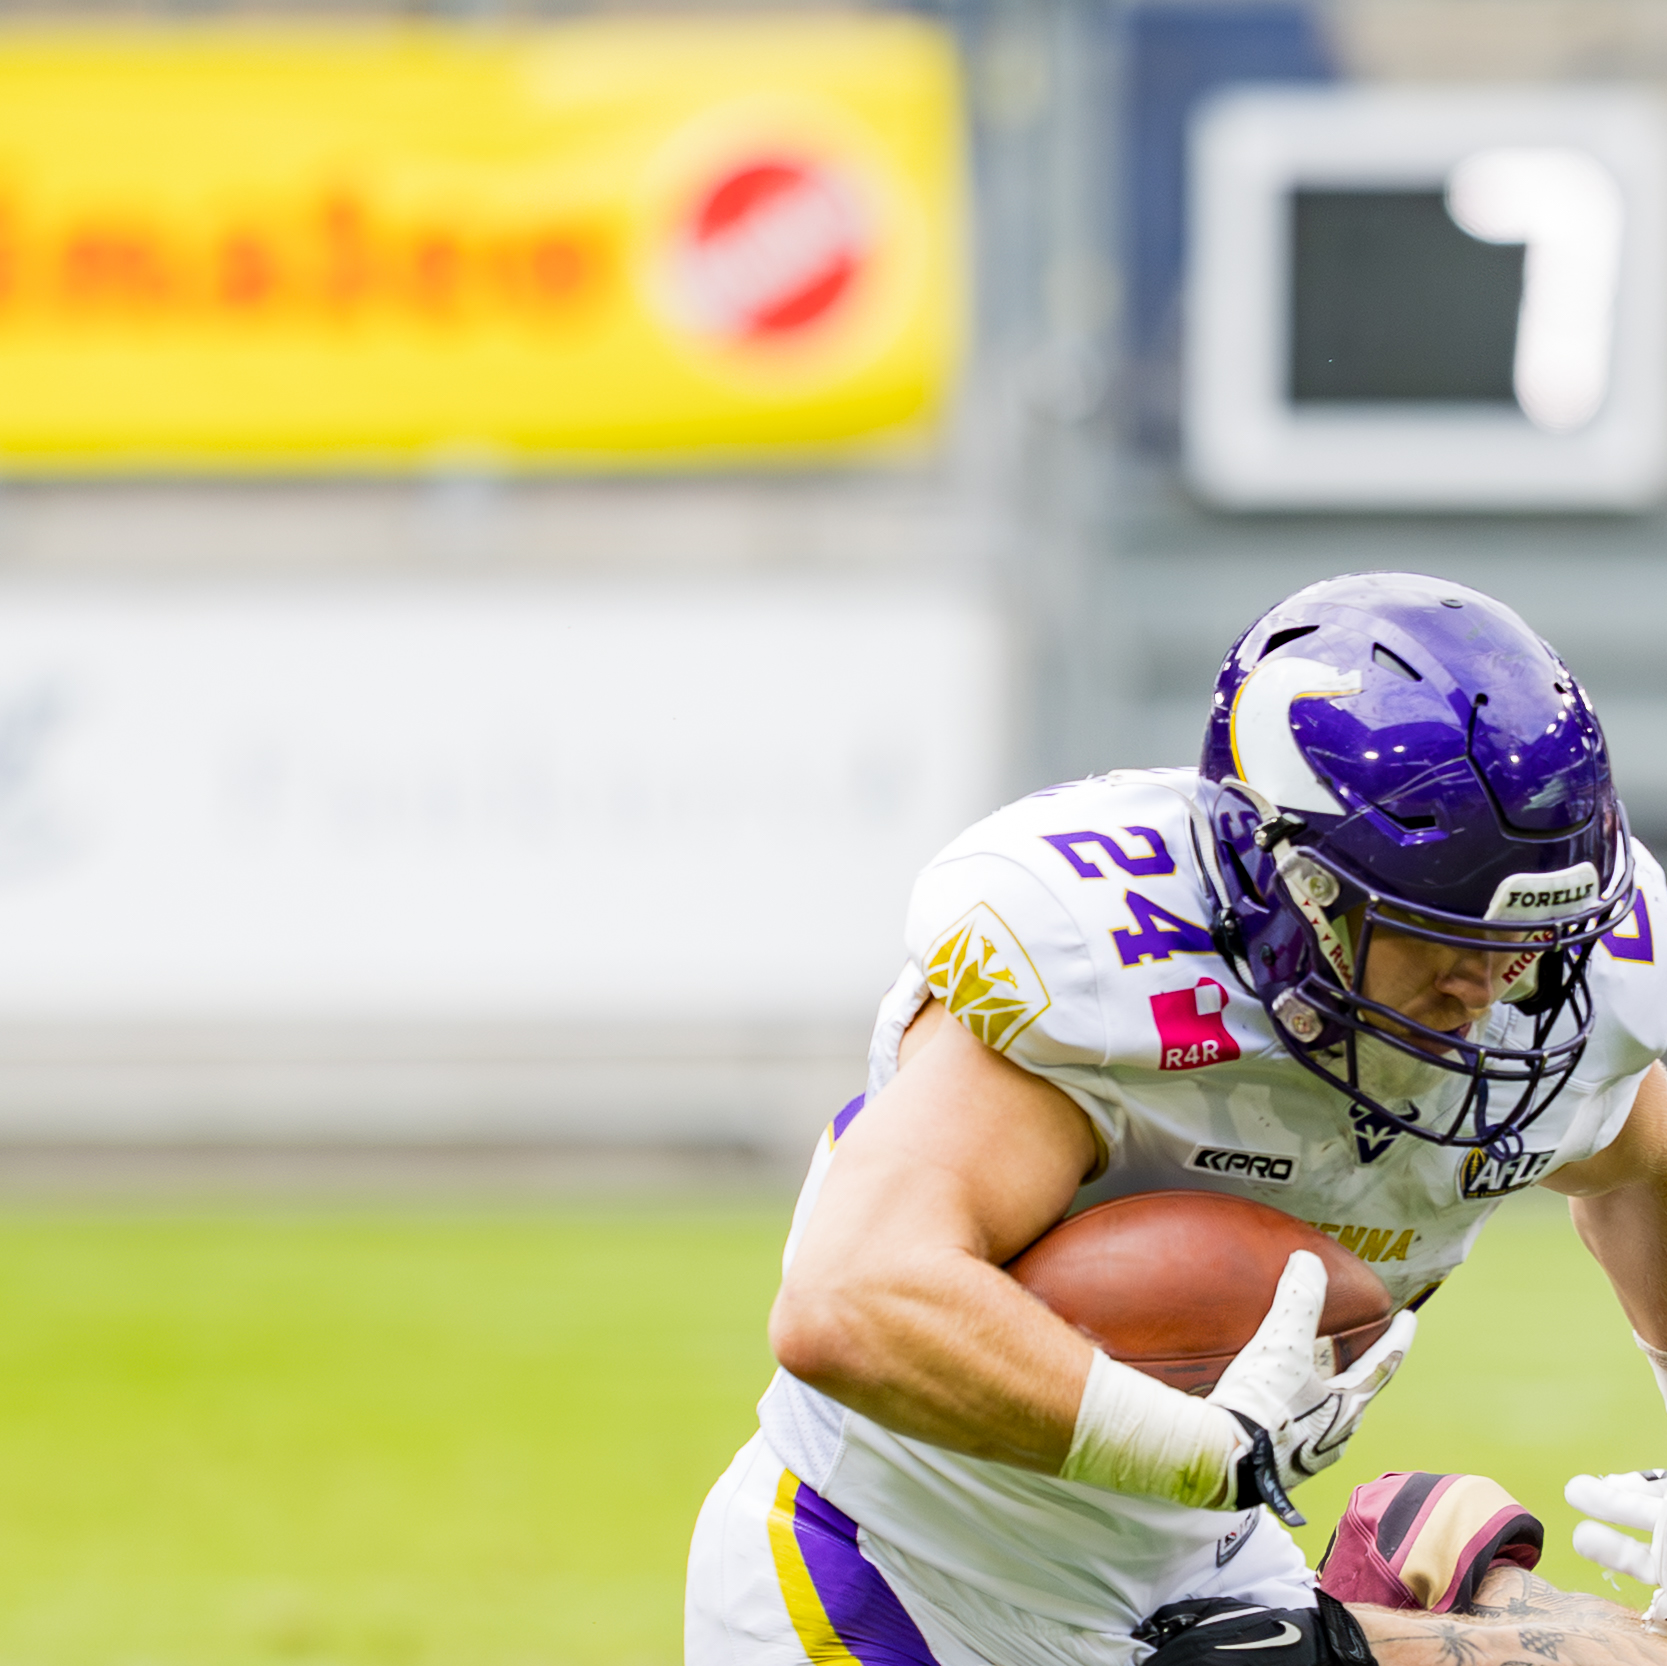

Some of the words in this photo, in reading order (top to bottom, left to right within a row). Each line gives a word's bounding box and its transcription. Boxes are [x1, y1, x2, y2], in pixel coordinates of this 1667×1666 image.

[1037, 825, 1218, 970] 24
[1506, 882, 1594, 908] FORELLE
[1165, 1039, 1219, 1068] R4R
